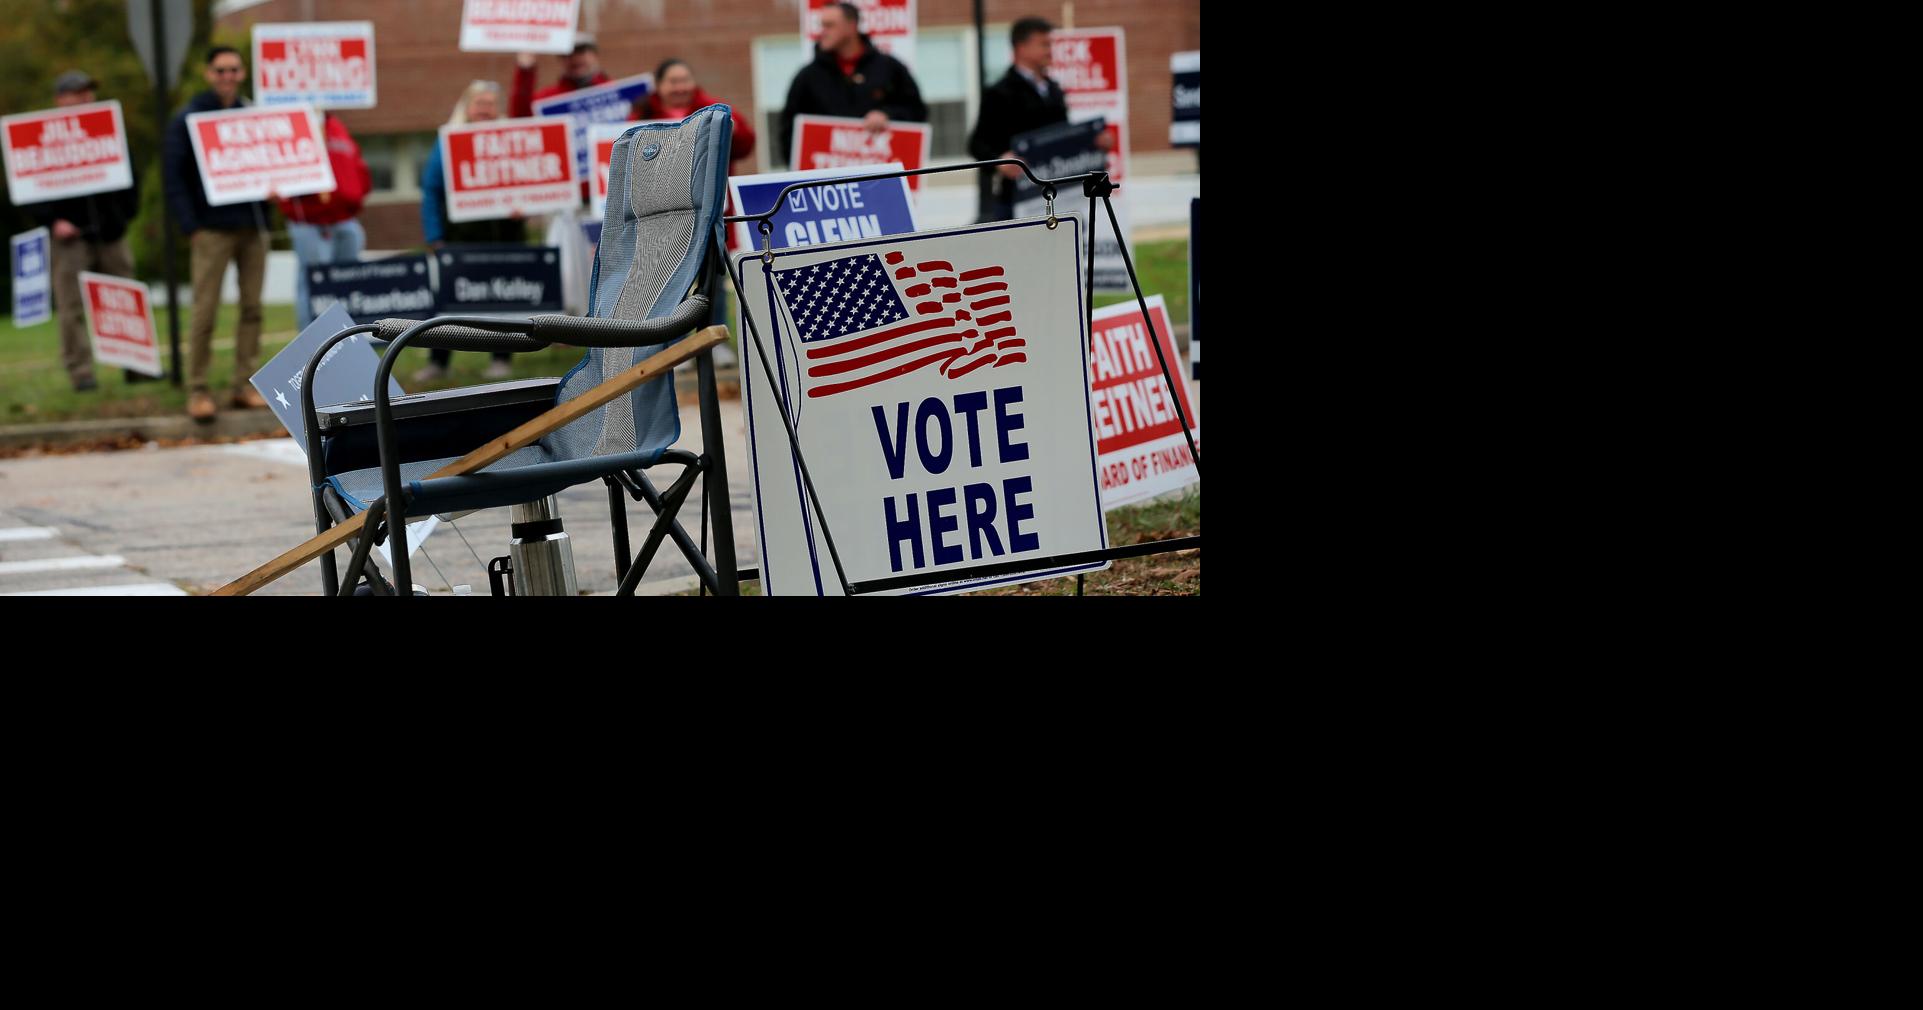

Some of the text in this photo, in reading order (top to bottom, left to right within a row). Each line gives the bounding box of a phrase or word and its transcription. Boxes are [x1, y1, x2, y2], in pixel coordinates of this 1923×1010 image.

[472, 127, 543, 159] FAITH
[831, 126, 893, 158] NICK
[460, 153, 564, 187] LEITNER
[806, 183, 864, 212] VOTE
[871, 386, 1029, 479] VOTE
[1132, 454, 1147, 480] OF
[883, 476, 1040, 572] HERE
